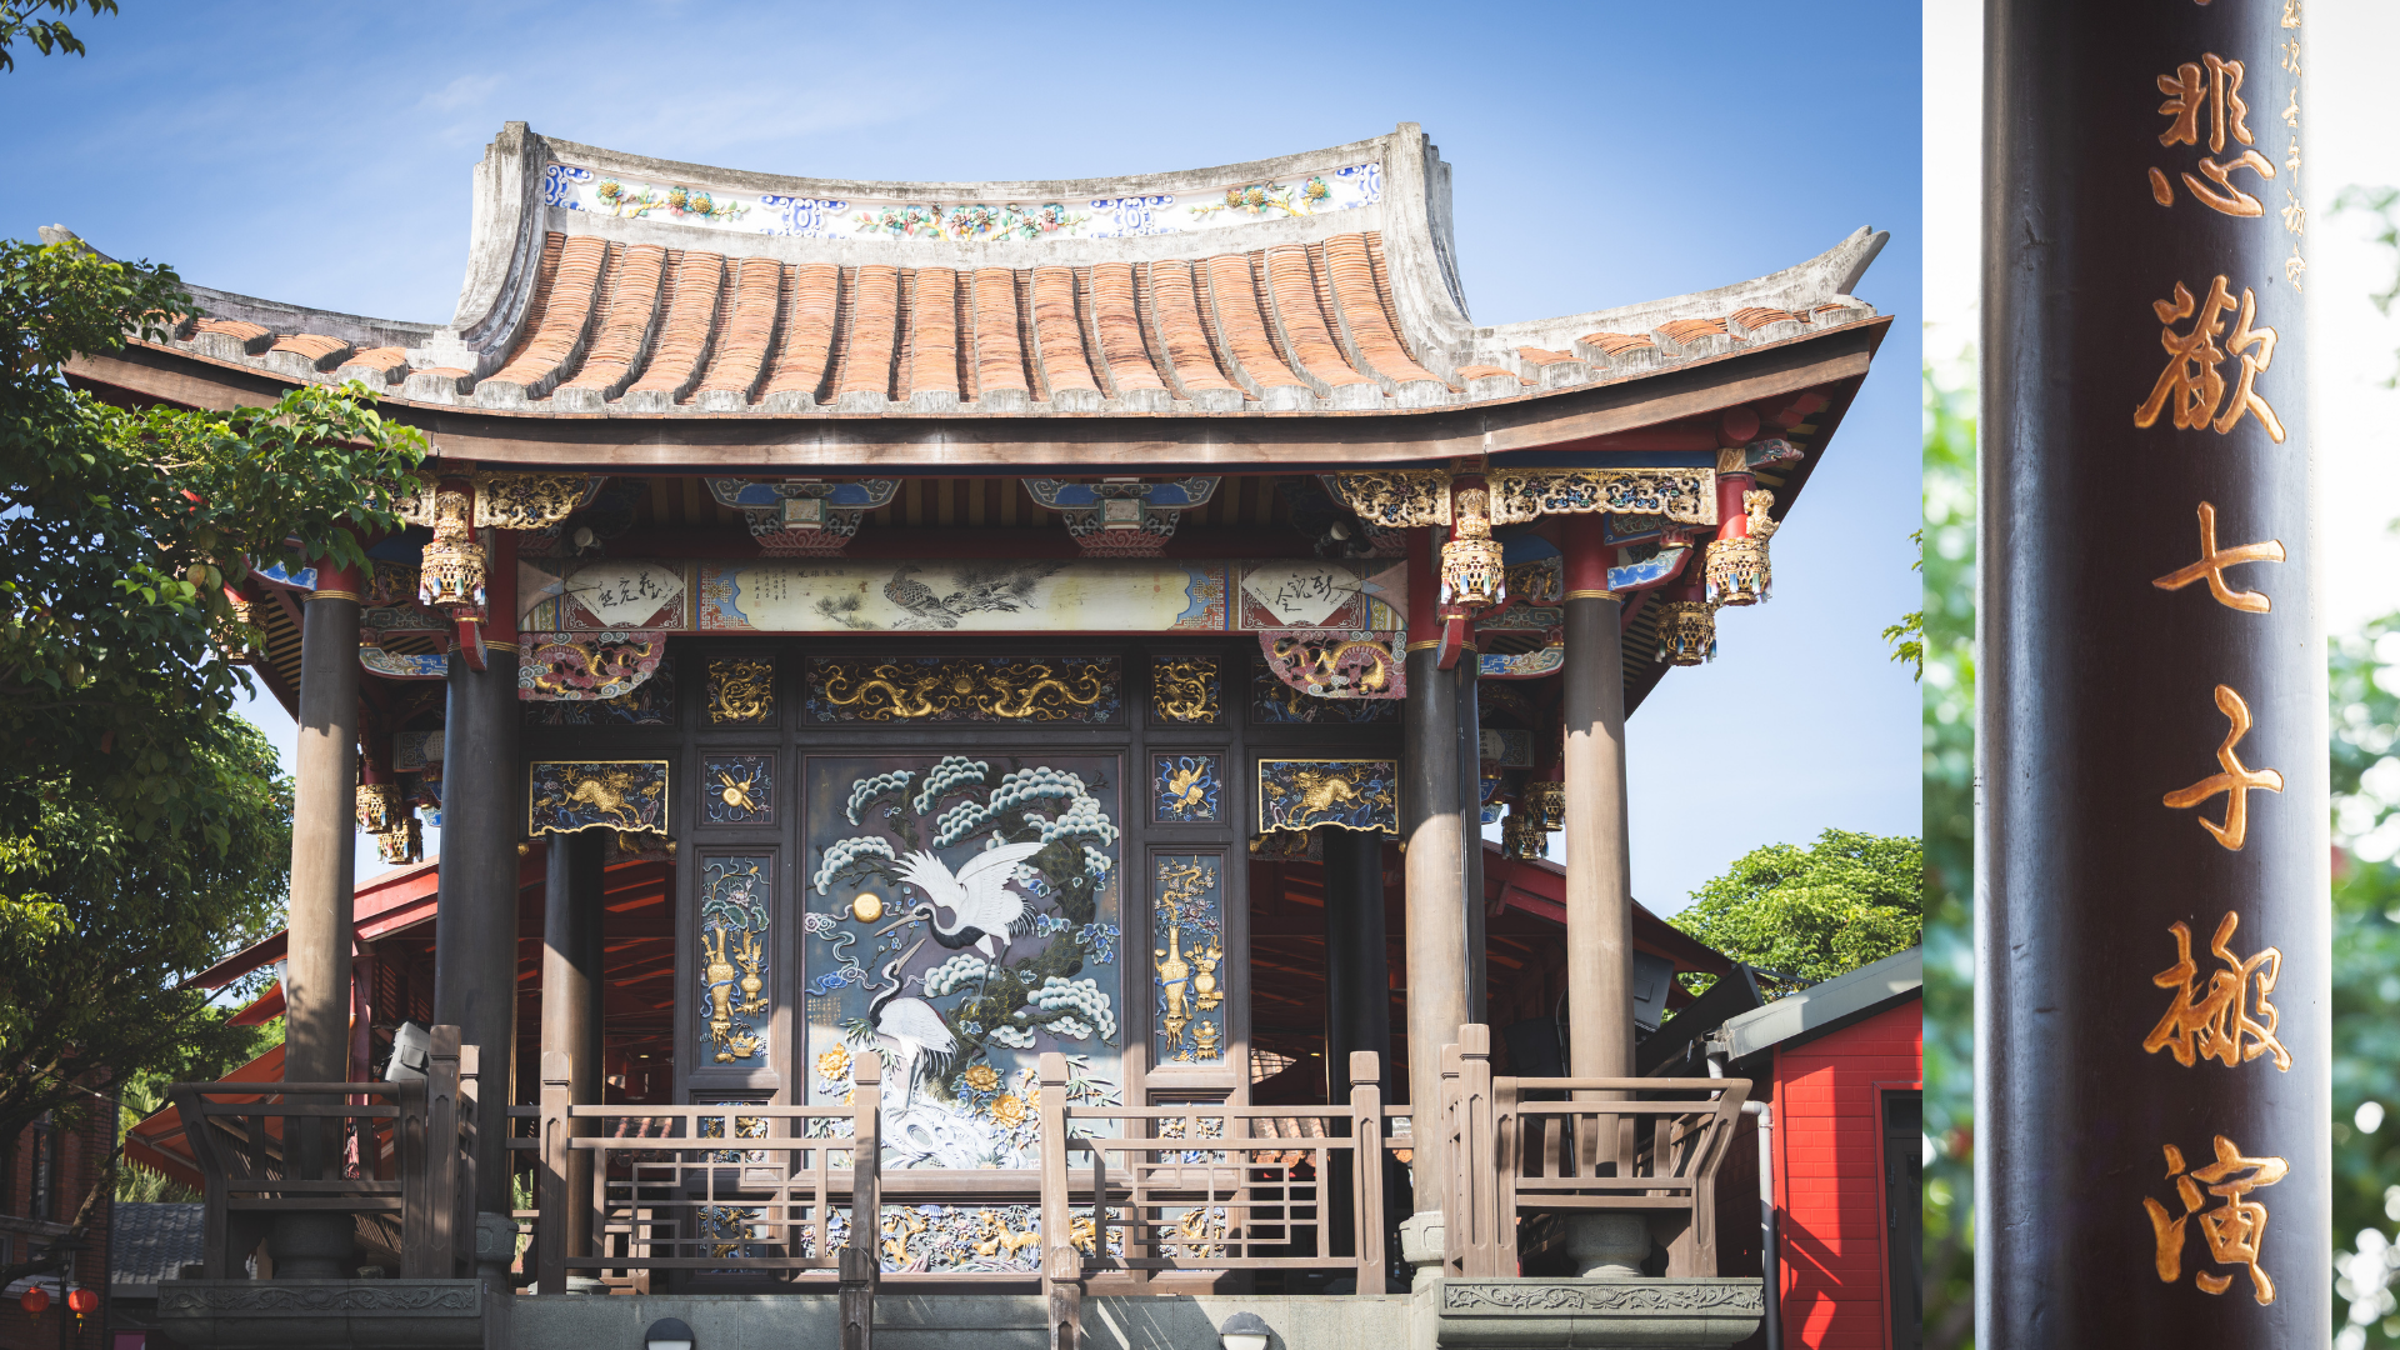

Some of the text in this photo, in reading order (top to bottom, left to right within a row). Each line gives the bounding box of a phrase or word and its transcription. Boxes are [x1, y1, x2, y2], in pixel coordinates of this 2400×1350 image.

[2134, 0, 2292, 1306] 悲歡七子搬演
